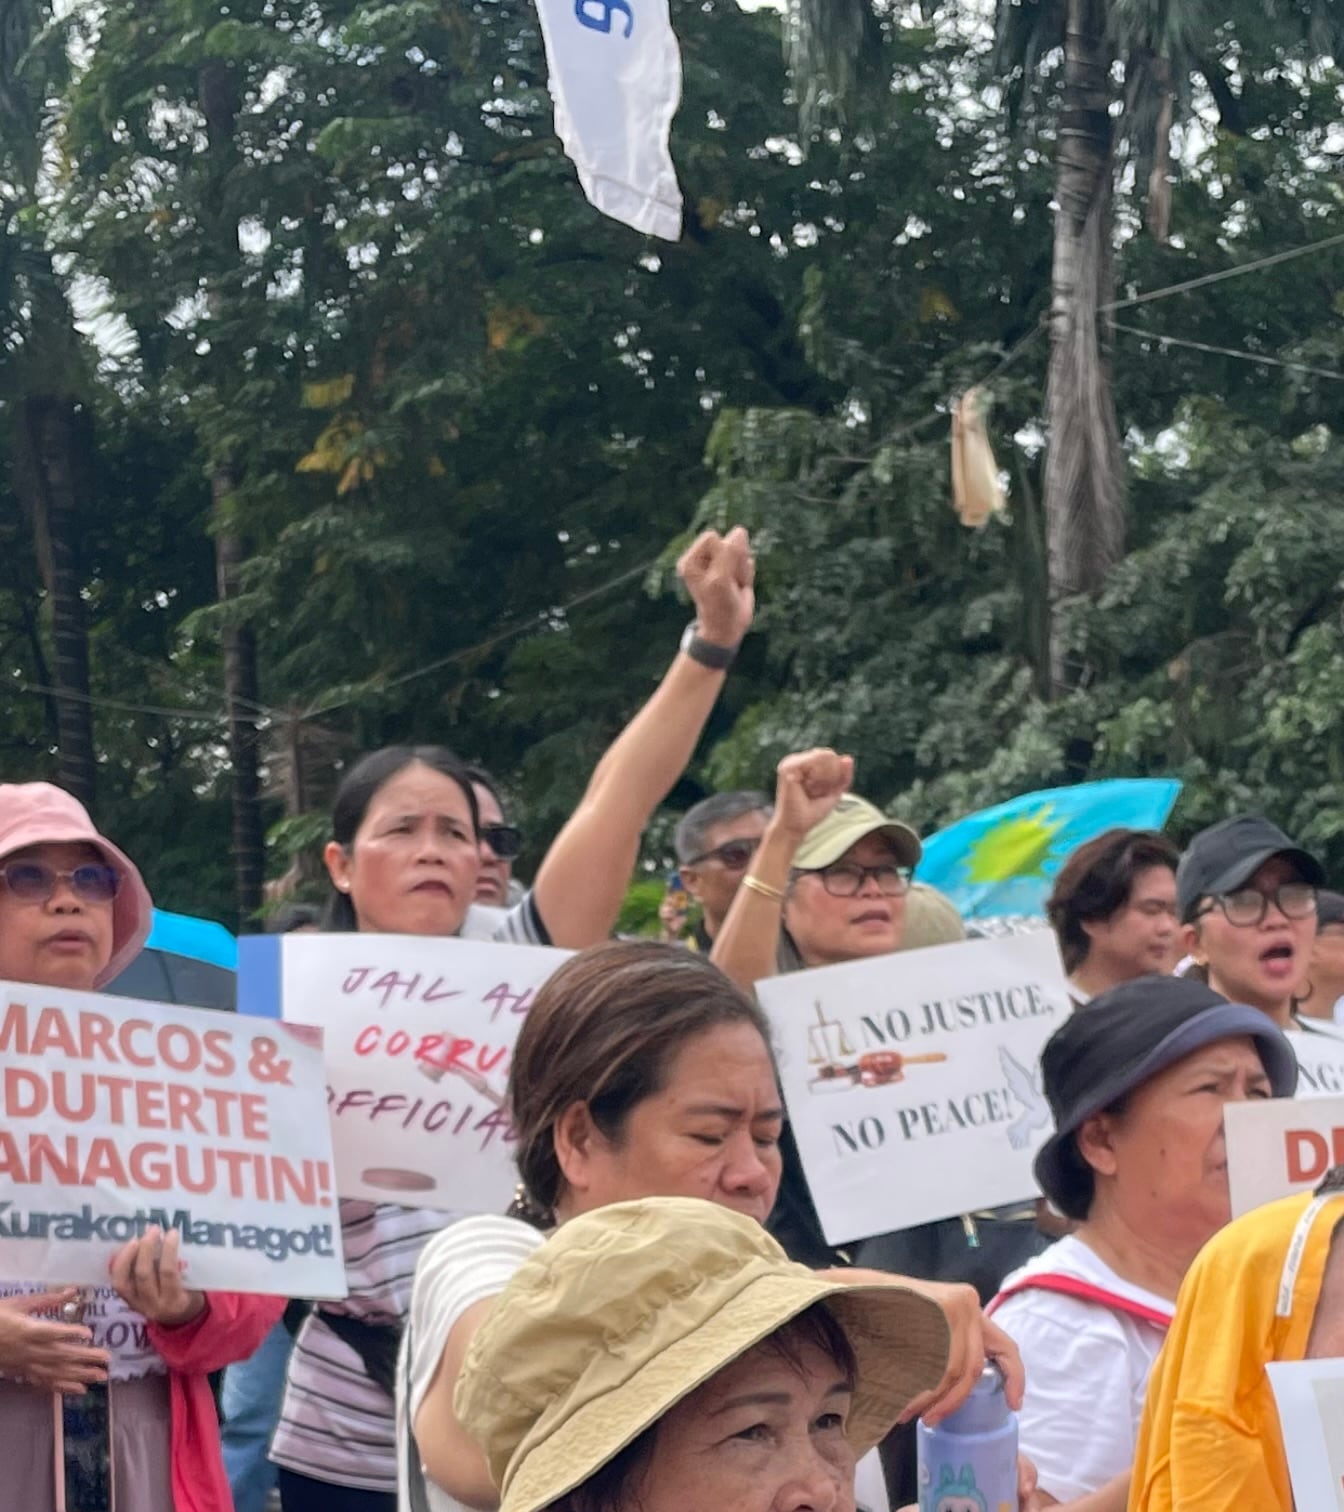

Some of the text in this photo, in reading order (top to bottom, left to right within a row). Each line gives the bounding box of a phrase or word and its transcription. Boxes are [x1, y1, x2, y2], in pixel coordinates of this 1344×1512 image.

[341, 967, 534, 1023] JAIL AL
[860, 983, 1055, 1049] NO JUSTICE,
[247, 1036, 294, 1085] &
[354, 1024, 510, 1077] CORRU
[3, 1067, 271, 1142] DUTERTE
[324, 1084, 522, 1152] FFICIAL
[831, 1085, 1013, 1156] NO PEACE!
